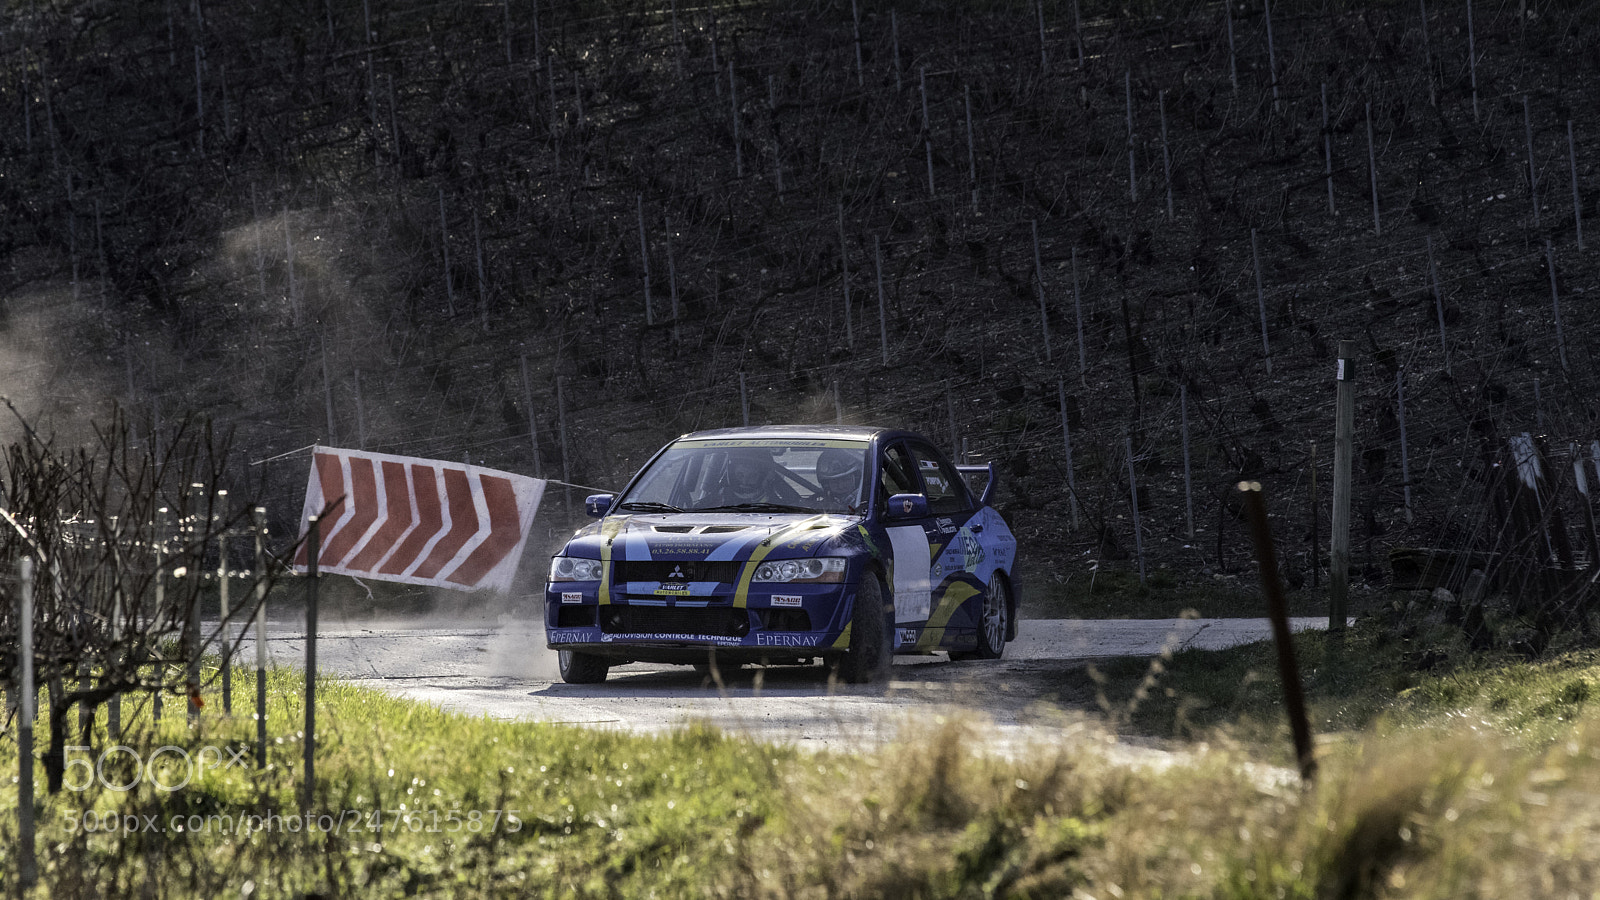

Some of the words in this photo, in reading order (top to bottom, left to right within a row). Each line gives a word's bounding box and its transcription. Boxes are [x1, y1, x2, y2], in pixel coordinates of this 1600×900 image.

[550, 631, 593, 643] EPERNAY
[698, 634, 742, 642] TECHNIQUE
[756, 633, 818, 646] EPERNAY
